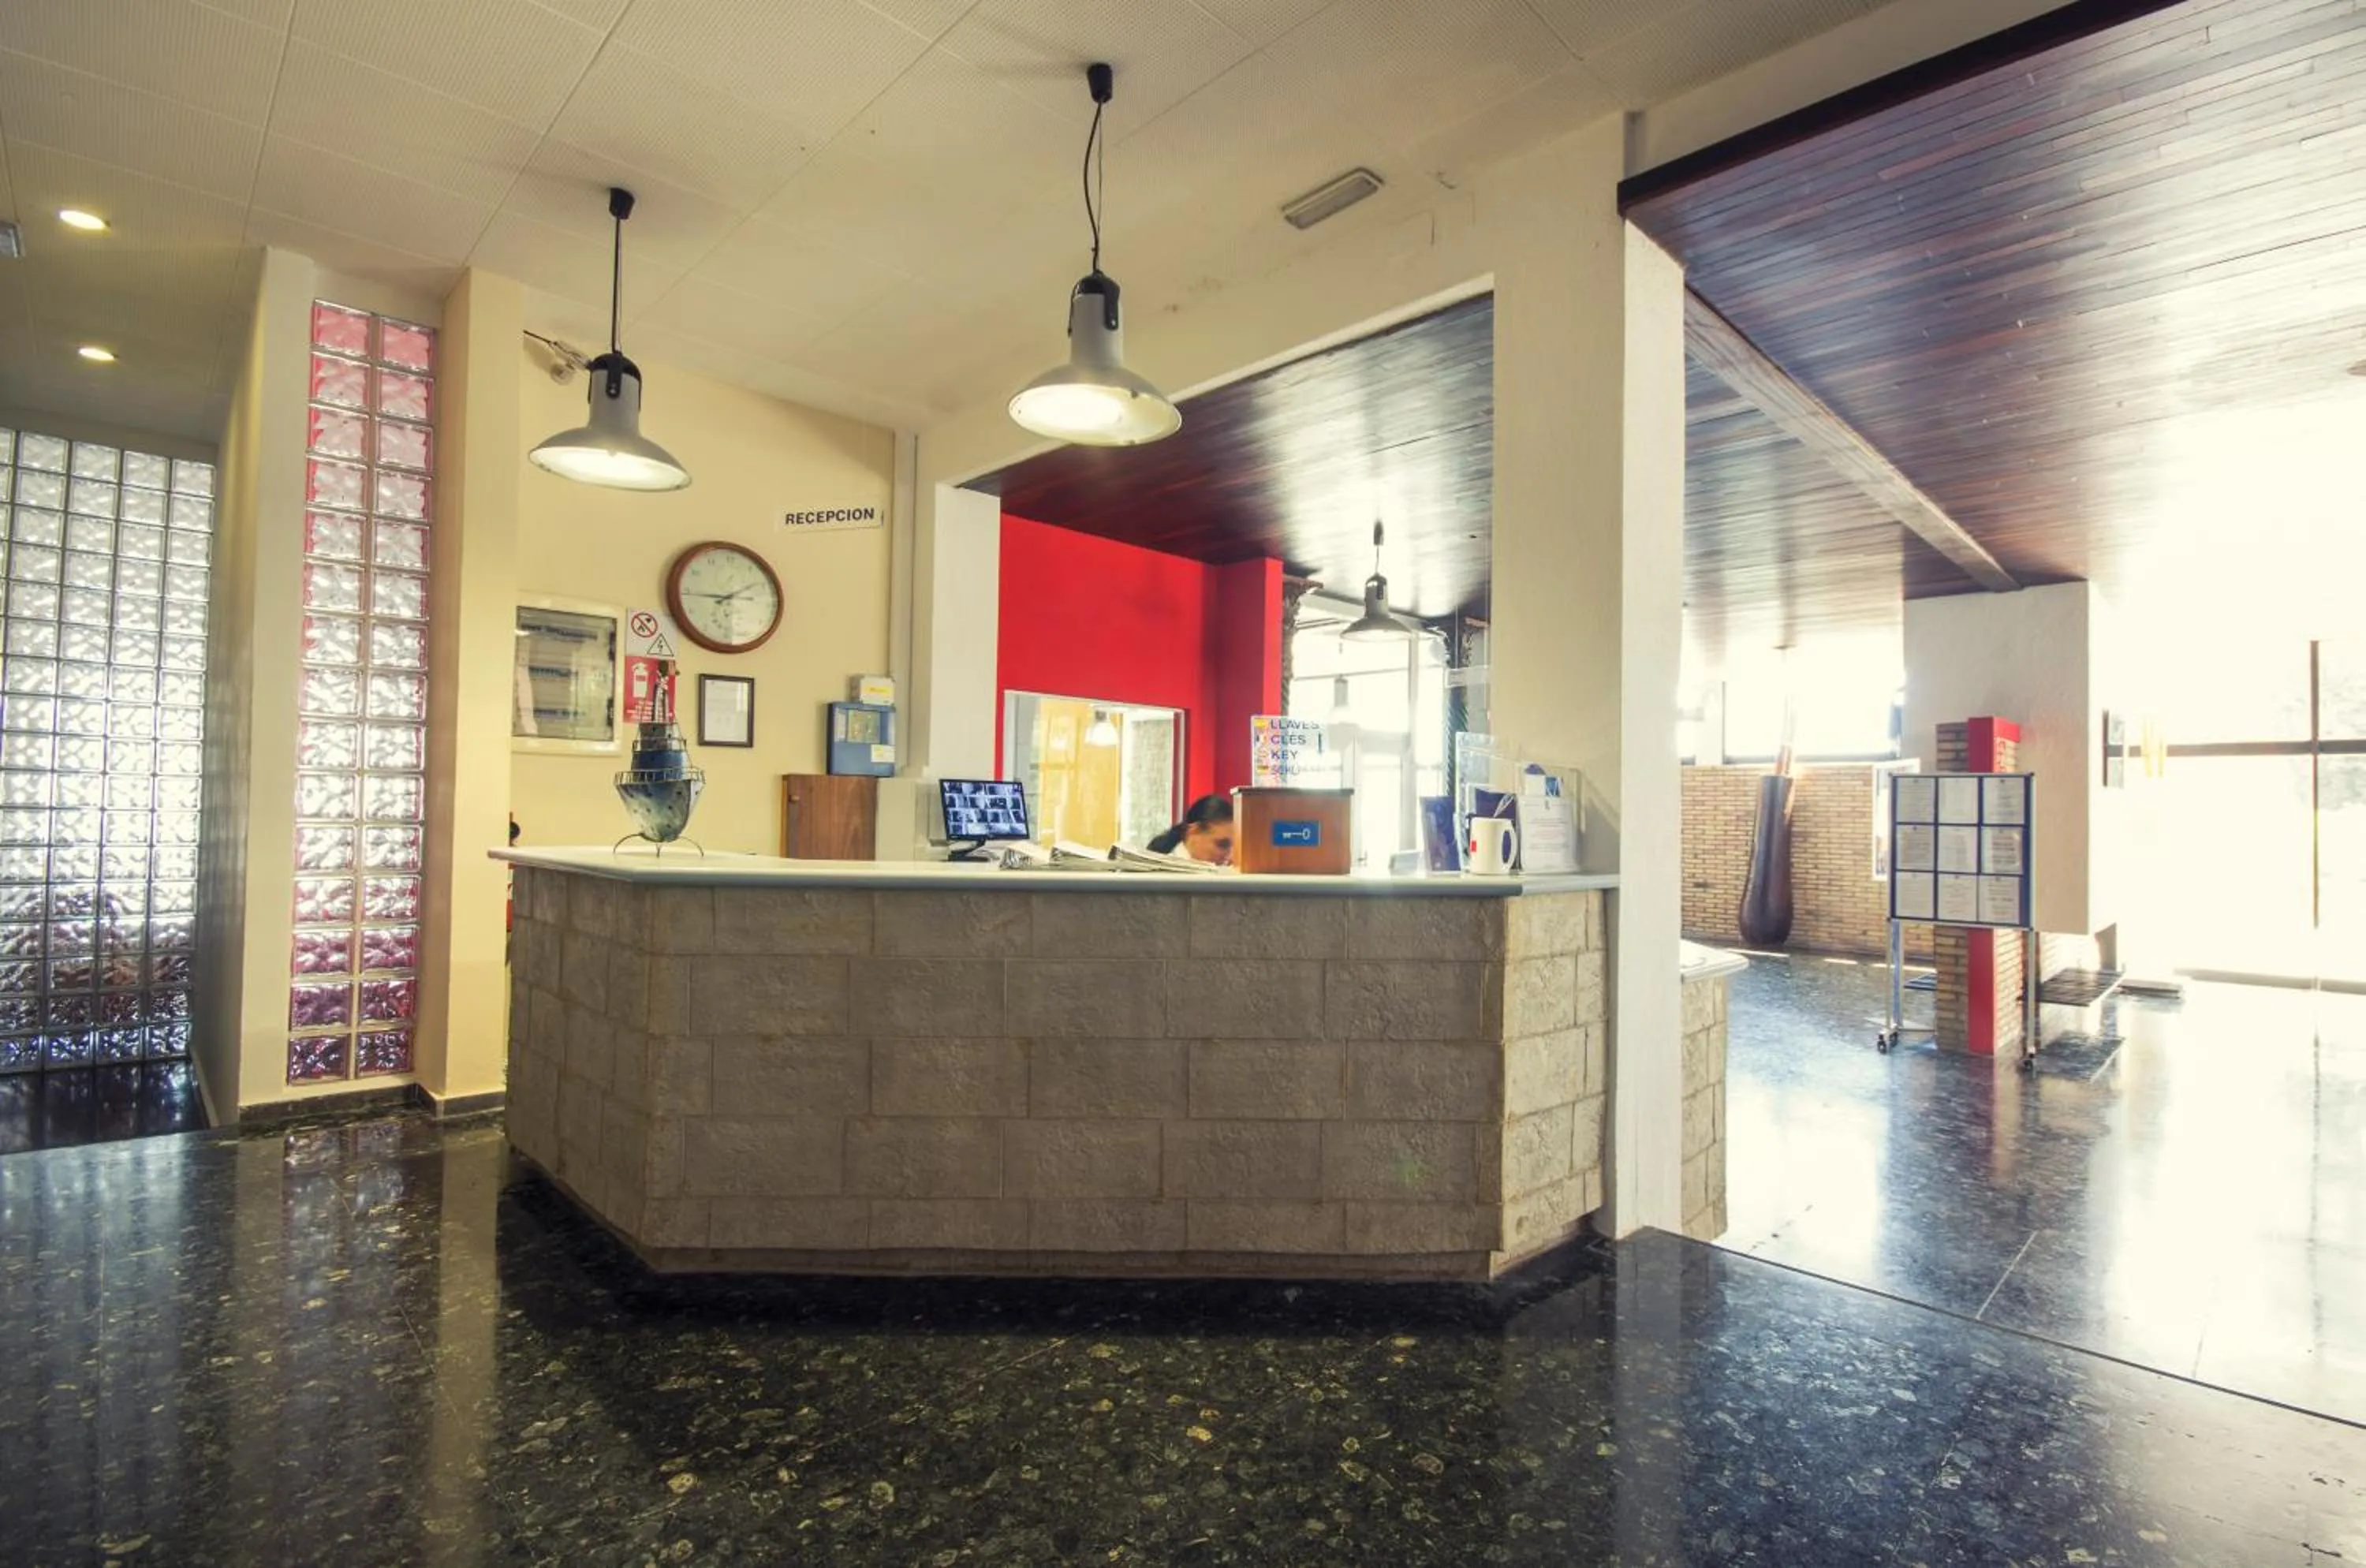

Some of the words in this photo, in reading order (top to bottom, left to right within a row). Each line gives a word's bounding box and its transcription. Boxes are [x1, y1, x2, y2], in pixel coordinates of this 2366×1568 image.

[785, 507, 875, 525] RECEPCION
[1270, 719, 1320, 730] LLAVES
[1271, 750, 1298, 760] KEY
